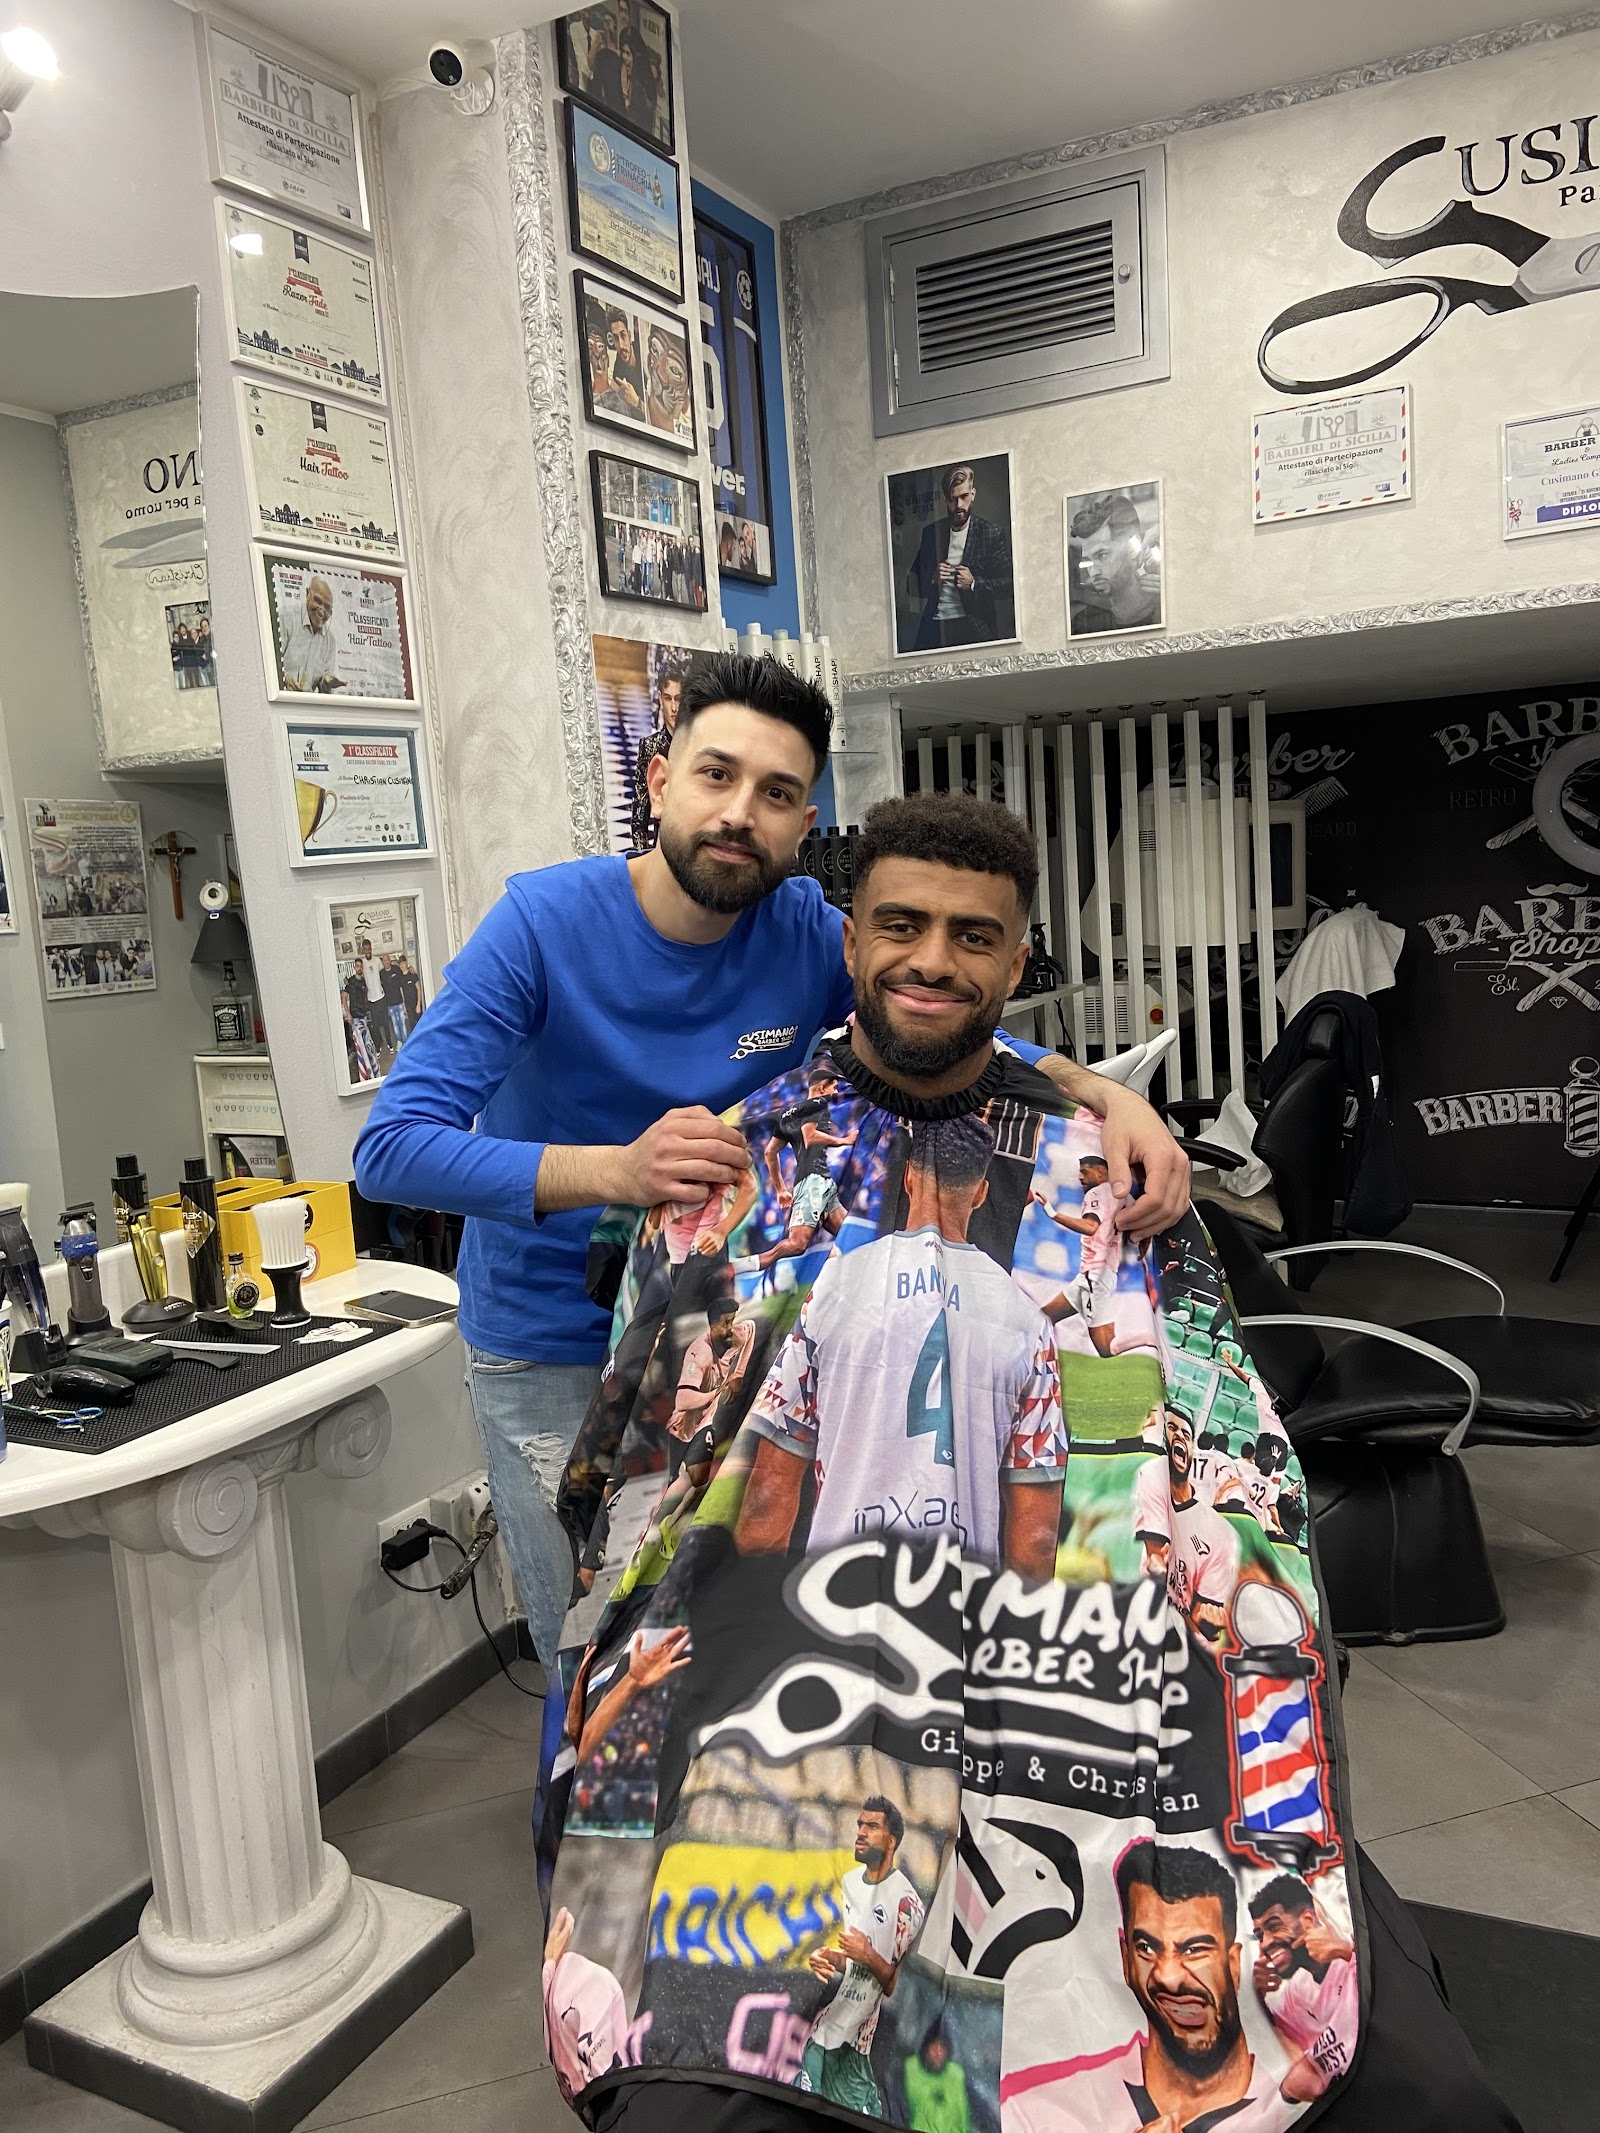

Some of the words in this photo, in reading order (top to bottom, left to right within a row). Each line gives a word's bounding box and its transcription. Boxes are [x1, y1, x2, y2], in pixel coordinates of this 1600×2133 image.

[224, 85, 282, 123] BARBIERI
[302, 121, 346, 152] SICILIA
[237, 111, 274, 136] Attestato
[275, 129, 284, 141] di
[284, 132, 341, 165] Partecipazione
[1559, 186, 1600, 207] Pa
[283, 285, 308, 303] Razor
[308, 294, 328, 310] Fade
[1267, 442, 1323, 461] BARBIERI
[1329, 441, 1341, 449] DI
[1345, 431, 1391, 447] SICILIA
[1544, 437, 1596, 453] BARBER
[300, 456, 320, 474] Hair
[321, 461, 349, 480] Tattoo
[1278, 460, 1314, 471] Attestato
[1315, 456, 1323, 465] di
[1324, 447, 1383, 463] Partecipazione
[1552, 457, 1578, 467] Ladies
[1304, 466, 1334, 477] rilasciato
[1541, 473, 1589, 486] Cusimano
[348, 633, 367, 645] Hair
[367, 635, 392, 648] Tattoo
[354, 745, 393, 757] CLASSIFICATO
[1413, 1090, 1565, 1137] BARBER
[907, 1307, 955, 1468] 4
[1193, 1458, 1208, 1480] 17
[963, 1640, 1095, 1690] RBER
[1118, 1645, 1190, 1716] SHP
[1028, 1756, 1046, 1781] &
